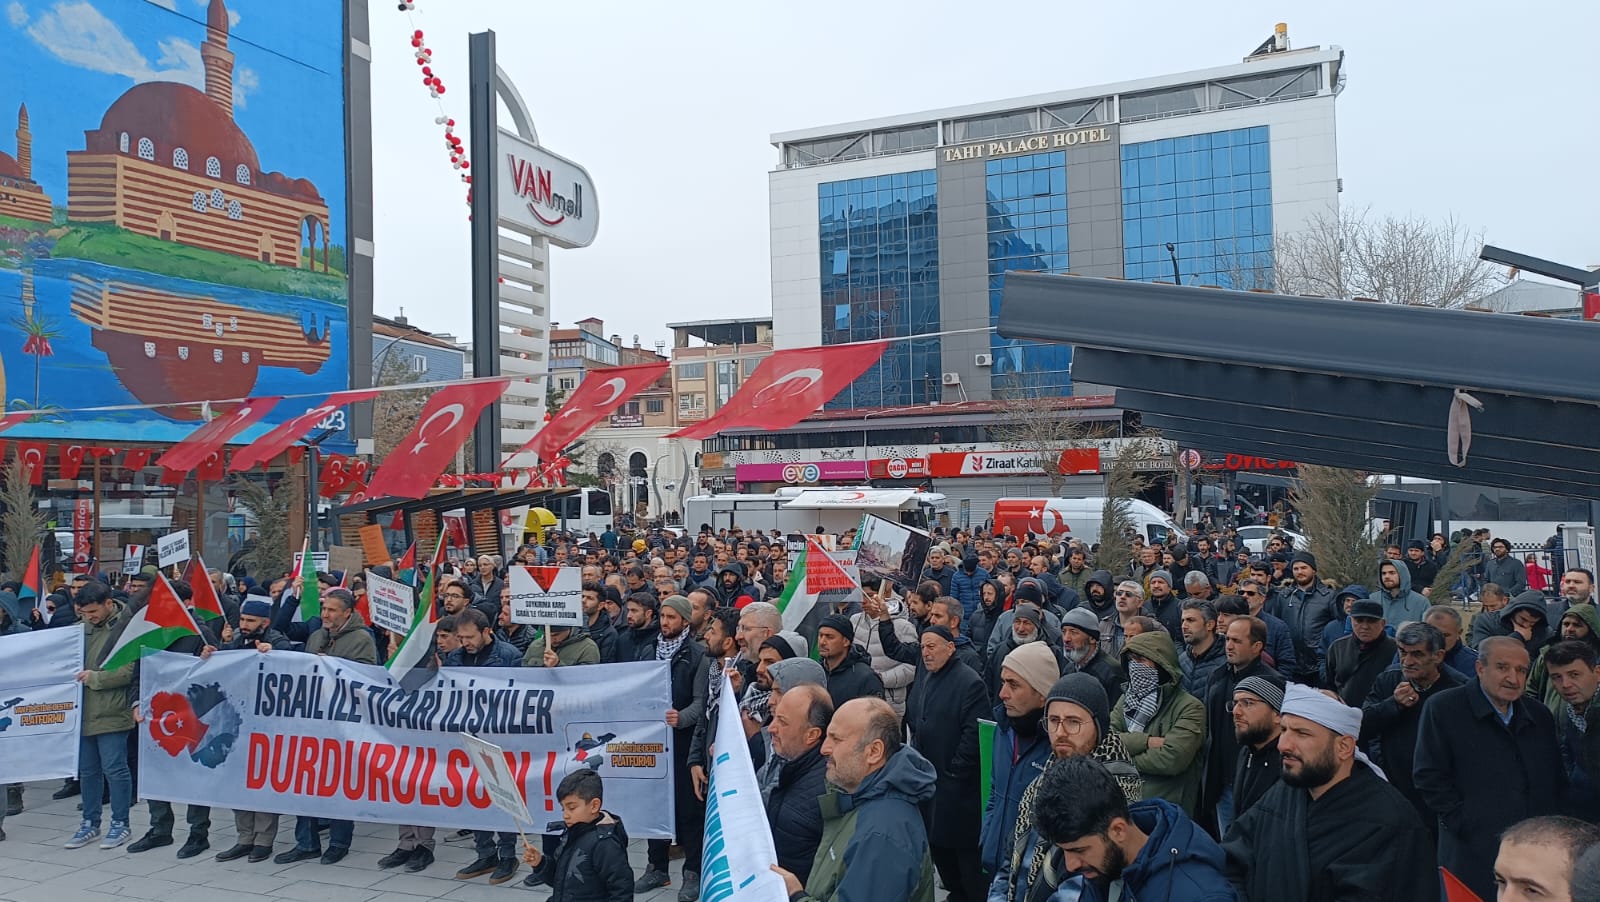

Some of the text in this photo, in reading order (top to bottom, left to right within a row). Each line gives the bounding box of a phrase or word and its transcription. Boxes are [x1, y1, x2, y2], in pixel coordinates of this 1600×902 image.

[943, 128, 1111, 161] TAHT PALACE HOTEL
[986, 458, 1015, 469] Ziraat
[783, 464, 820, 483] eve
[254, 662, 554, 737] İSRAİL İLE TİCARİ İLİŞKİLER
[20, 711, 66, 727] PLATFORMU
[611, 755, 657, 768] PLATFORMU
[543, 751, 557, 811] !
